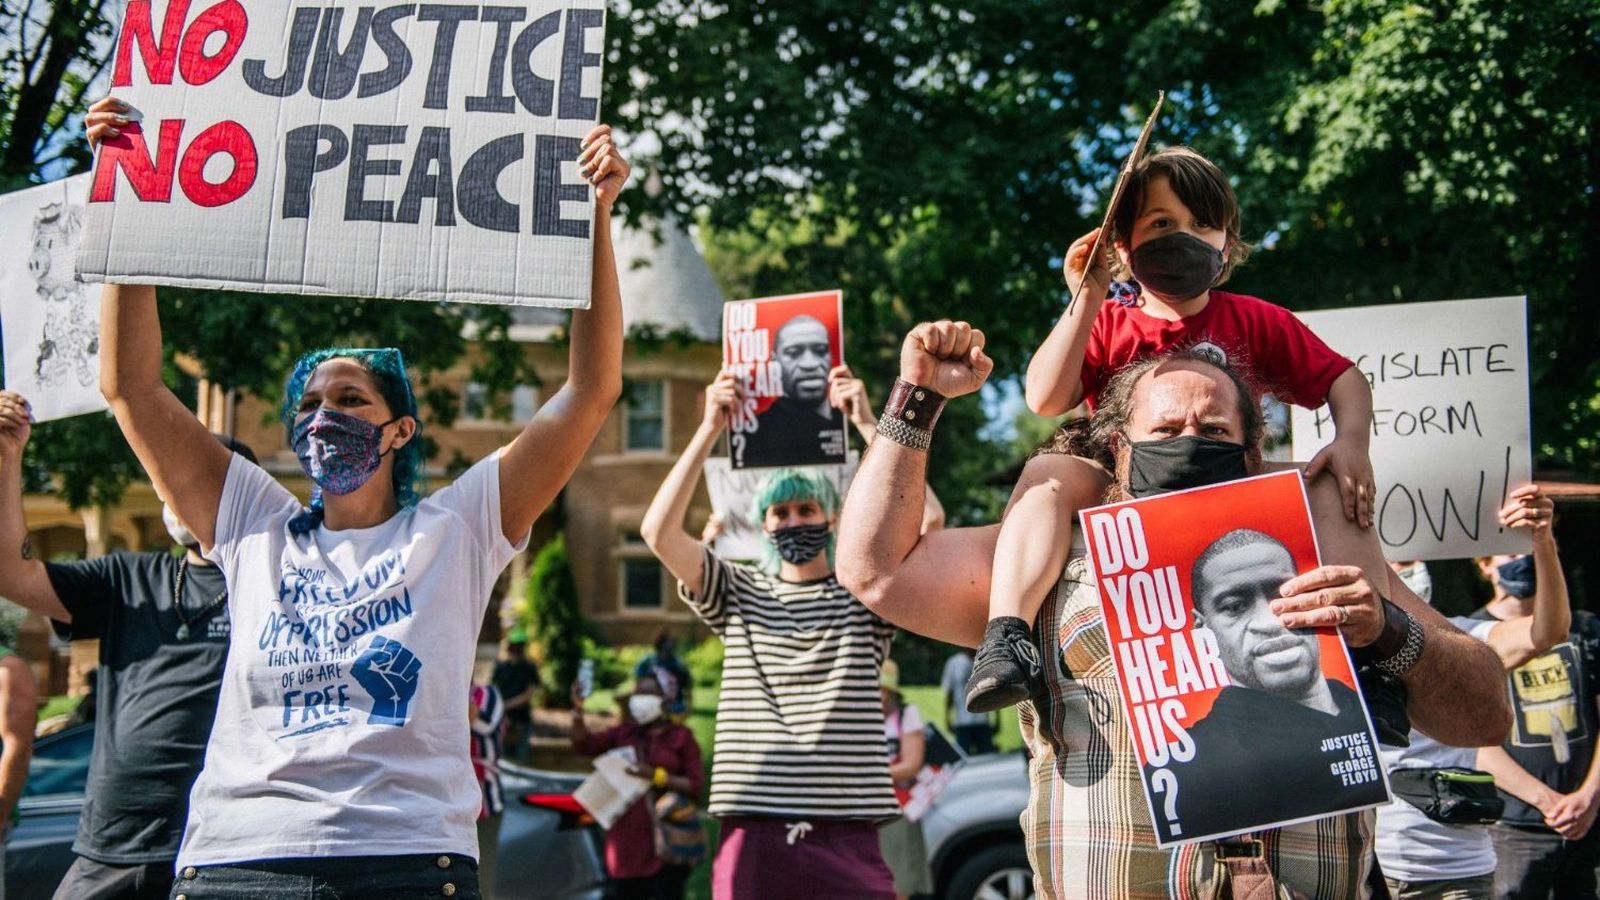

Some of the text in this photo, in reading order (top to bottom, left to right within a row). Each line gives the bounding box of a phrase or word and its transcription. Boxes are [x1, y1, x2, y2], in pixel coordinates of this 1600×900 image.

[112, 0, 603, 120] NO JUSTICE
[89, 118, 590, 238] NO PEACE
[730, 303, 757, 332] DO
[728, 328, 769, 364] YOU
[1356, 343, 1515, 390] GISLATE
[732, 433, 746, 468] ?
[1378, 446, 1511, 547] OW!
[1090, 507, 1150, 576] DO
[259, 587, 412, 650] OPPRESSION
[1102, 565, 1187, 639] YOU
[268, 643, 357, 667] THEN NEITHER
[282, 662, 342, 689] OF US ARE
[1118, 627, 1232, 704] HEAR
[283, 684, 350, 727] FREE
[1133, 698, 1197, 768] US
[1320, 731, 1369, 752] JUSTICE
[1348, 743, 1373, 760] FOR
[1330, 755, 1375, 776] GEORGE
[1341, 768, 1378, 787] FLOYD
[1151, 768, 1182, 836] ?
